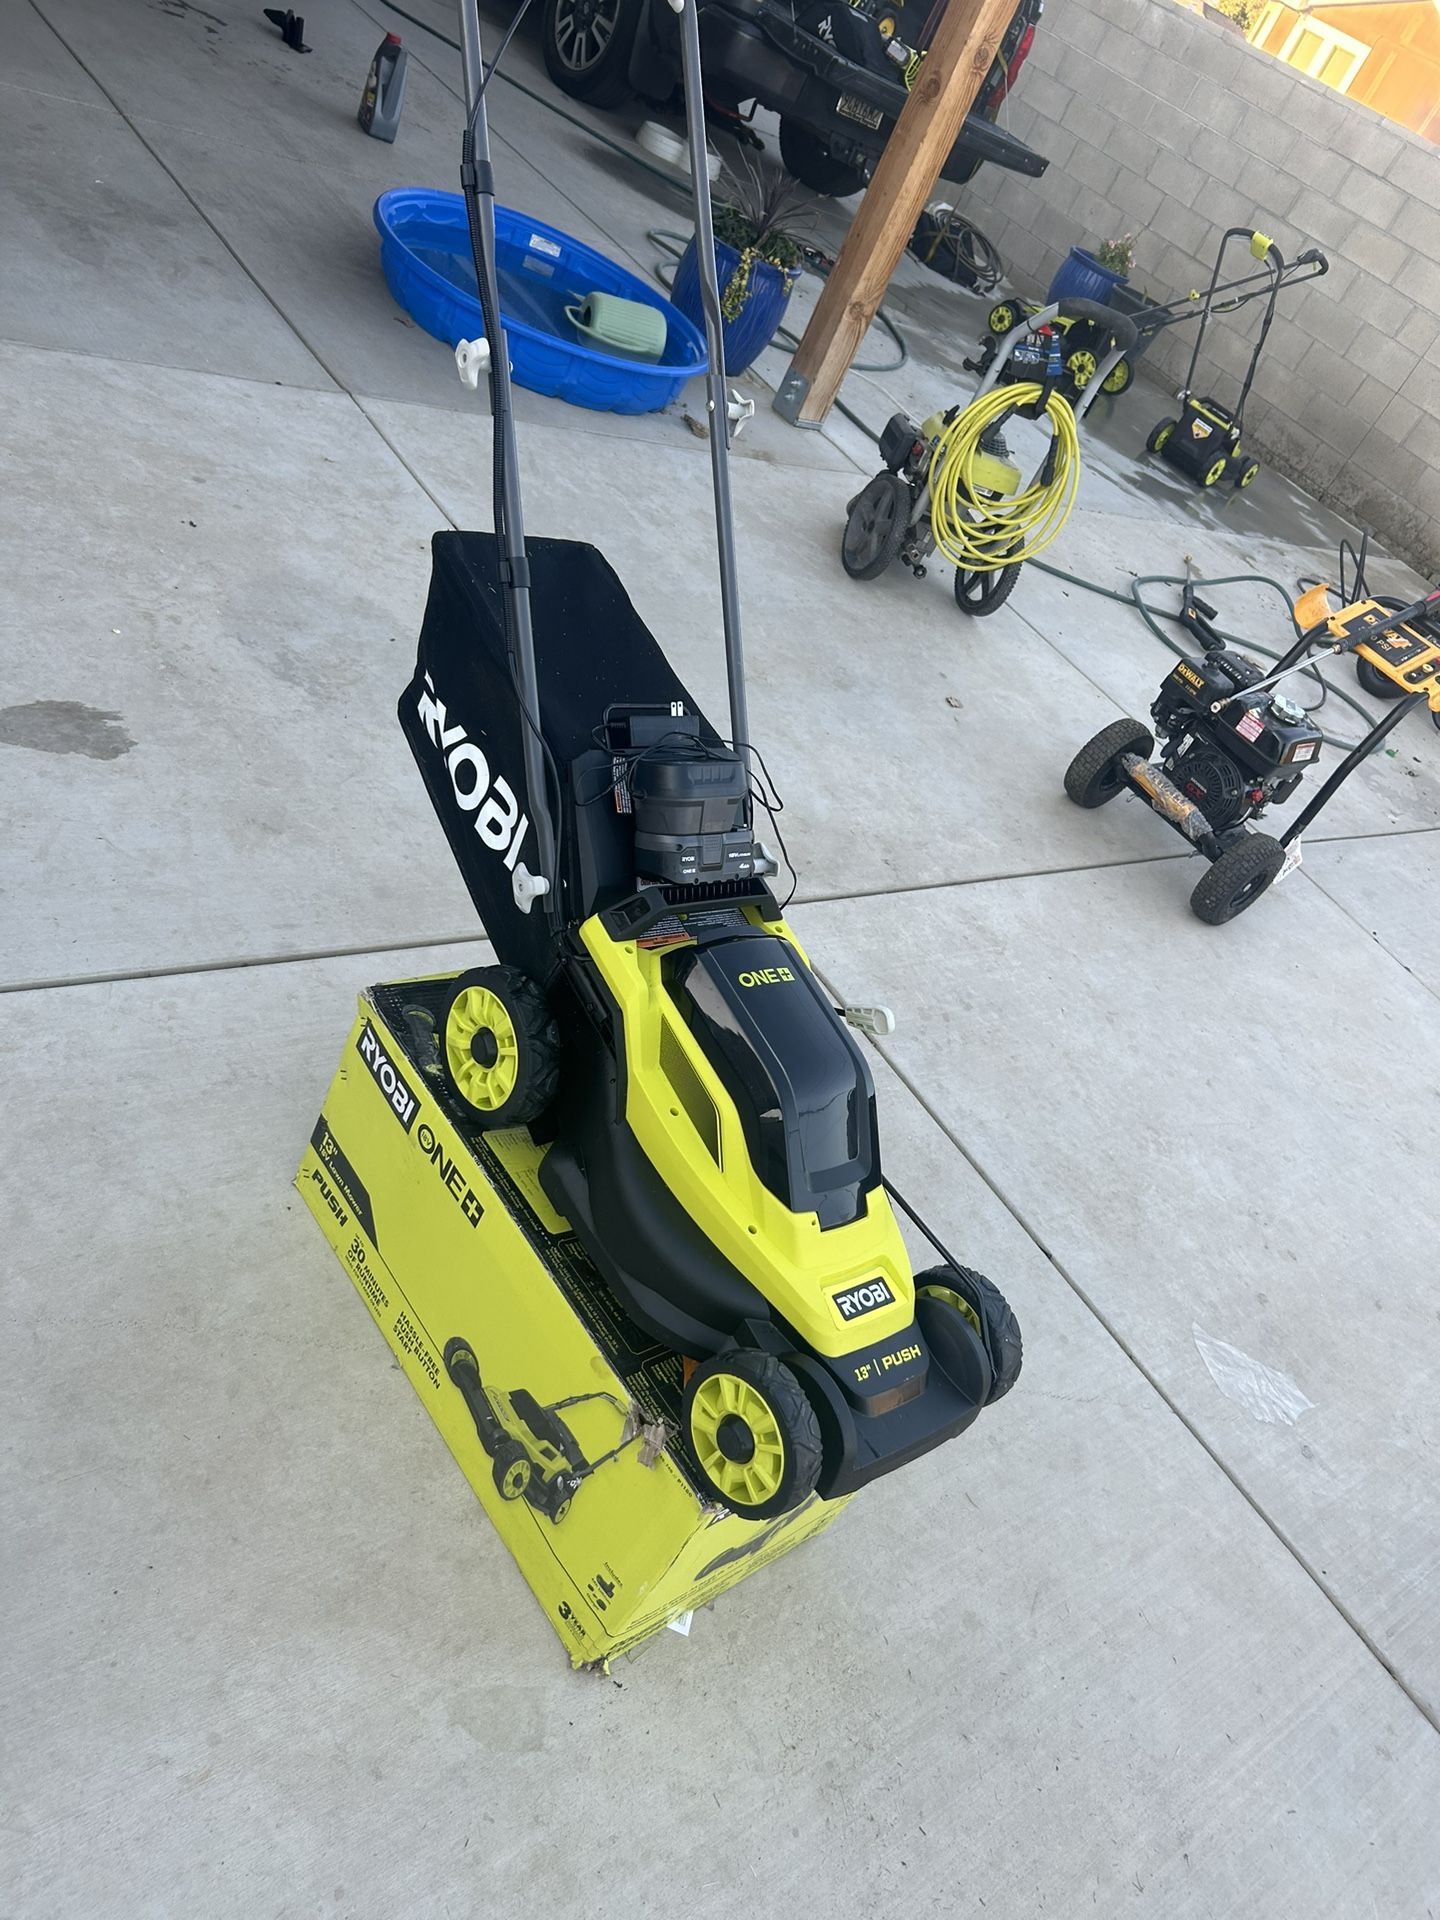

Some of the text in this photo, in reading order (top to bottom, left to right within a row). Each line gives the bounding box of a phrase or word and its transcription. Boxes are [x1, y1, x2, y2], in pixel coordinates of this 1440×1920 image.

[361, 1026, 415, 1123] RYOBI
[311, 1168, 348, 1227] PUSH
[347, 1249, 381, 1307] OF RUNTIME
[351, 1238, 389, 1308] 30 MINUTES
[836, 1281, 891, 1316] RYOBI
[392, 1324, 412, 1354] START
[396, 1318, 440, 1389] PUSH BUTTON
[399, 1311, 440, 1376] HASSLE-FREE
[881, 1344, 922, 1370] PUSH
[558, 1600, 571, 1620] 3
[570, 1613, 586, 1637] YEAR
